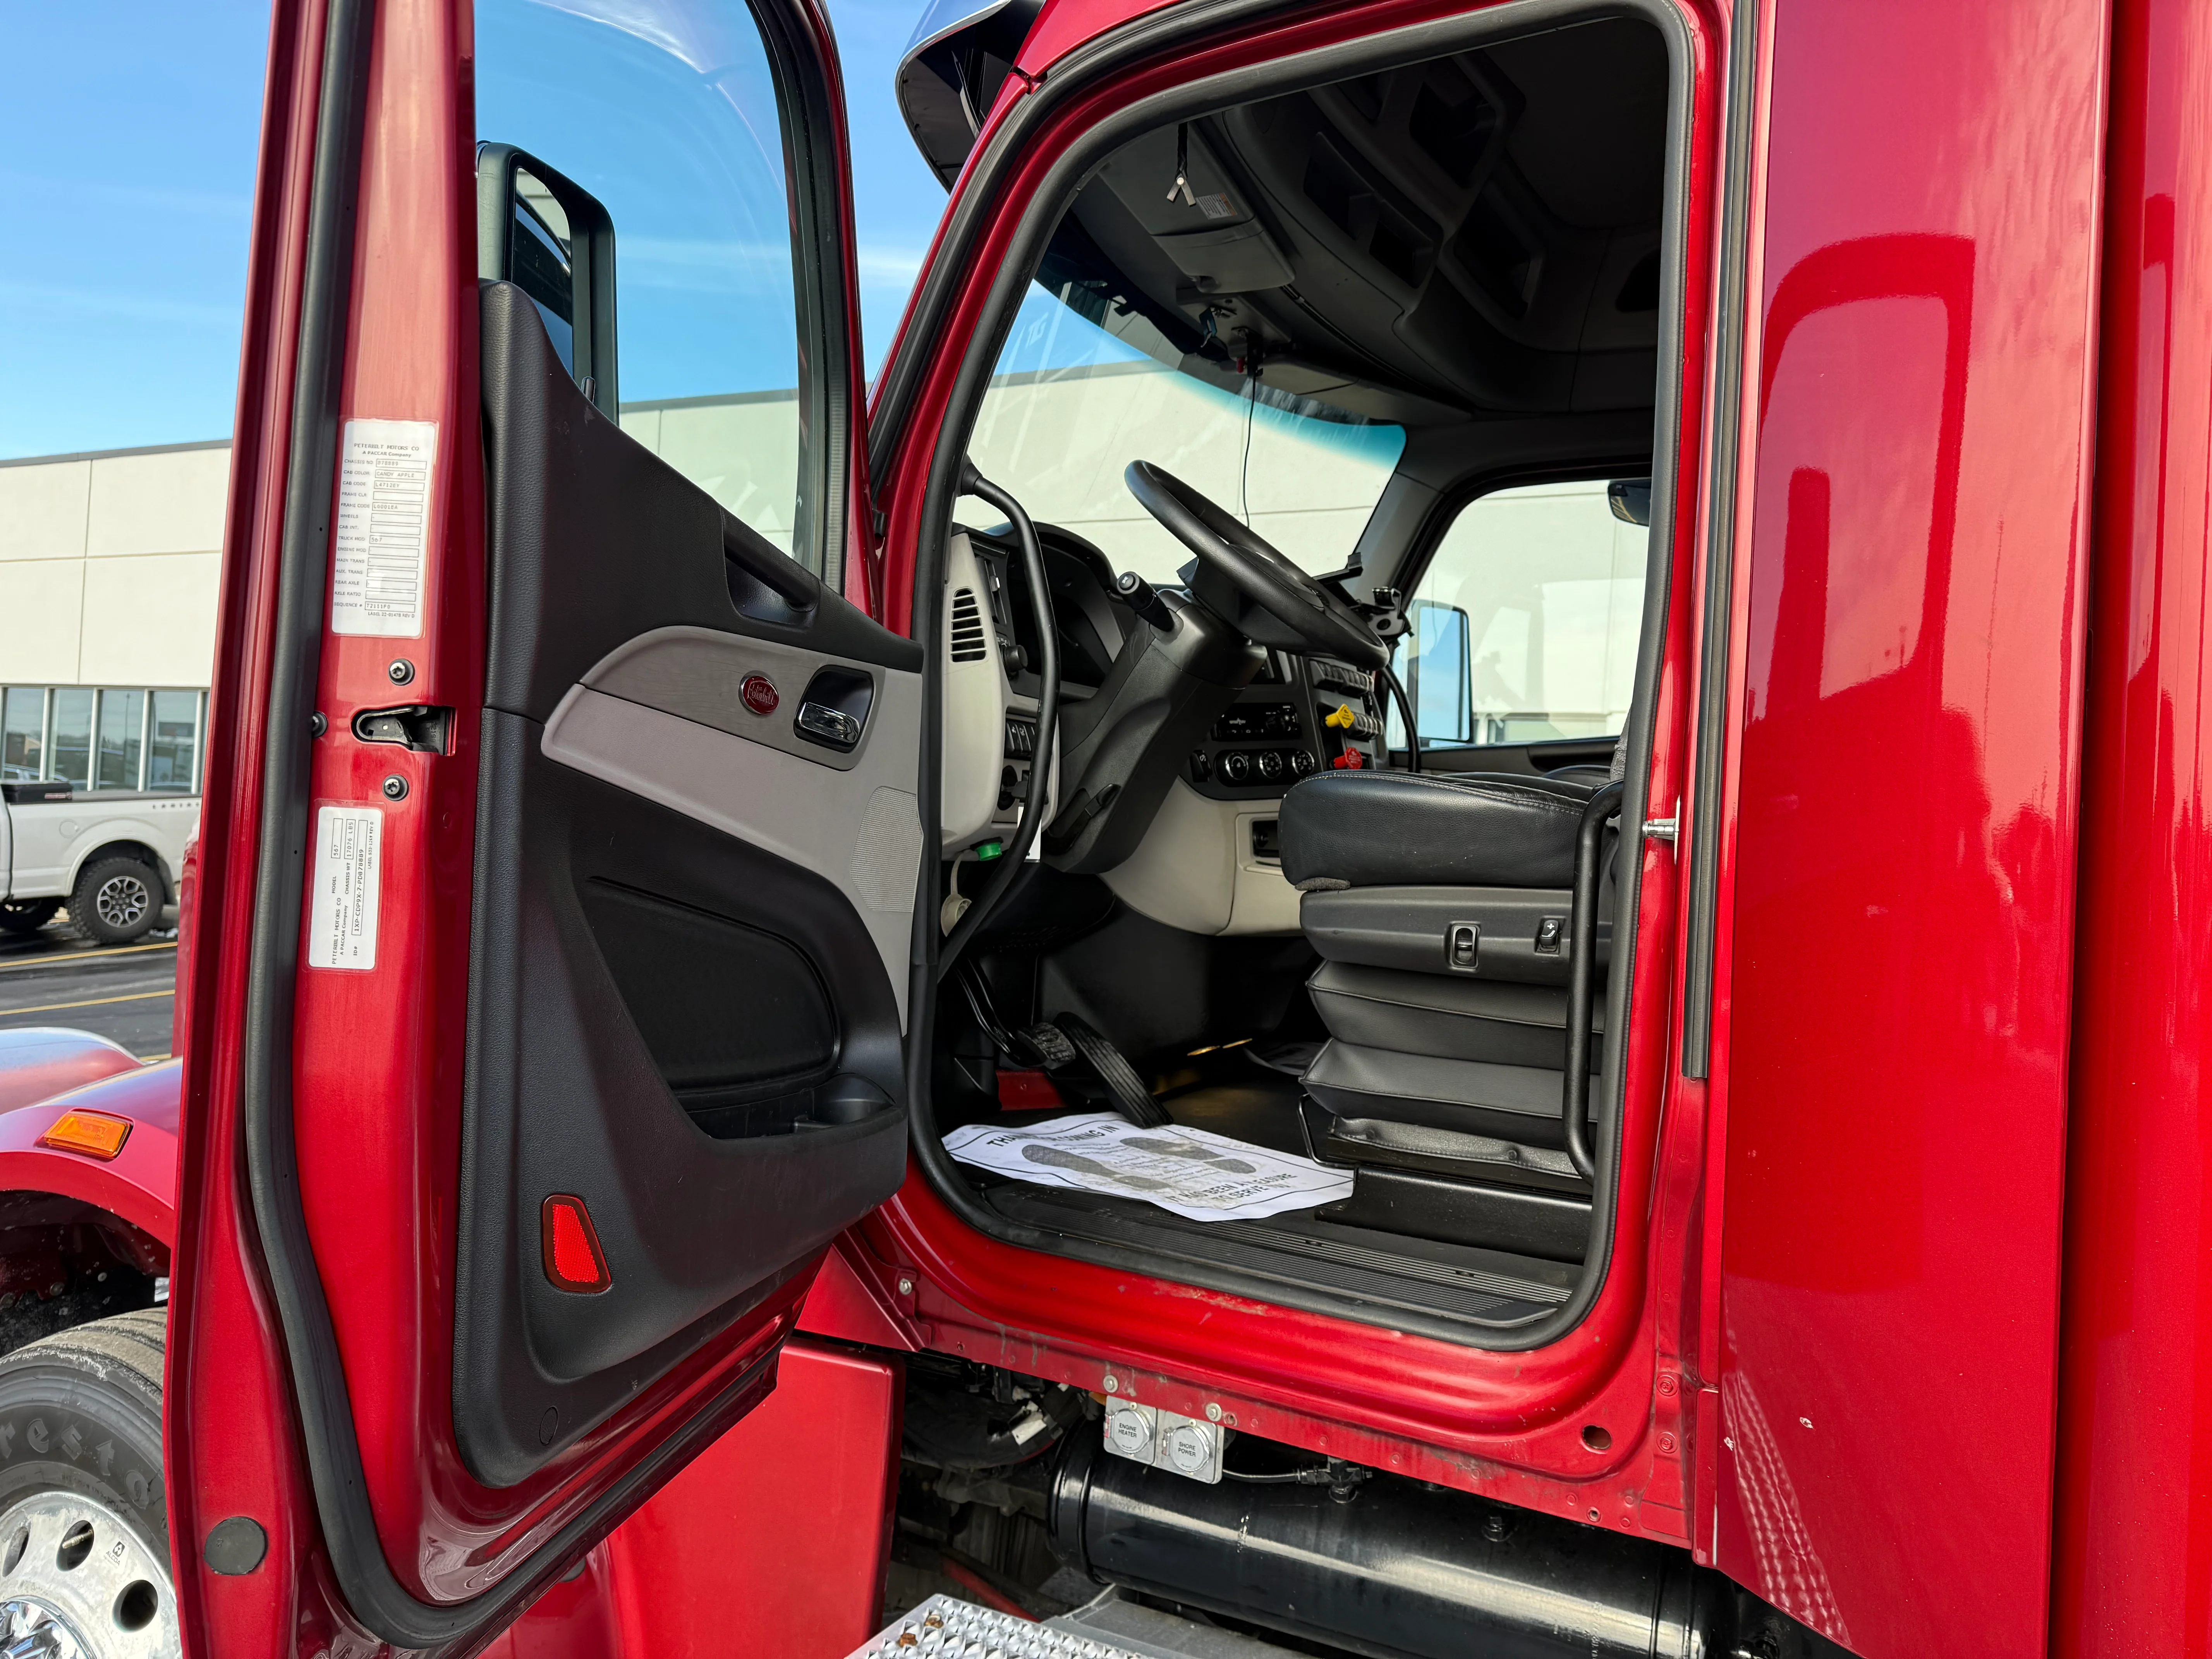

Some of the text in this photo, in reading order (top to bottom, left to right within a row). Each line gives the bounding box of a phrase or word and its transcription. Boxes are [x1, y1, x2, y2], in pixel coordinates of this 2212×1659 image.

[347, 862, 350, 871] WT
[337, 897, 341, 906] CO
[1097, 1125, 1120, 1133] IN
[1119, 1423, 1137, 1432] ENGINE
[1118, 1429, 1137, 1438] HEATER
[1179, 1441, 1196, 1451] SHORE
[1178, 1447, 1196, 1457] POWER
[106, 1551, 120, 1566] ALCOA
